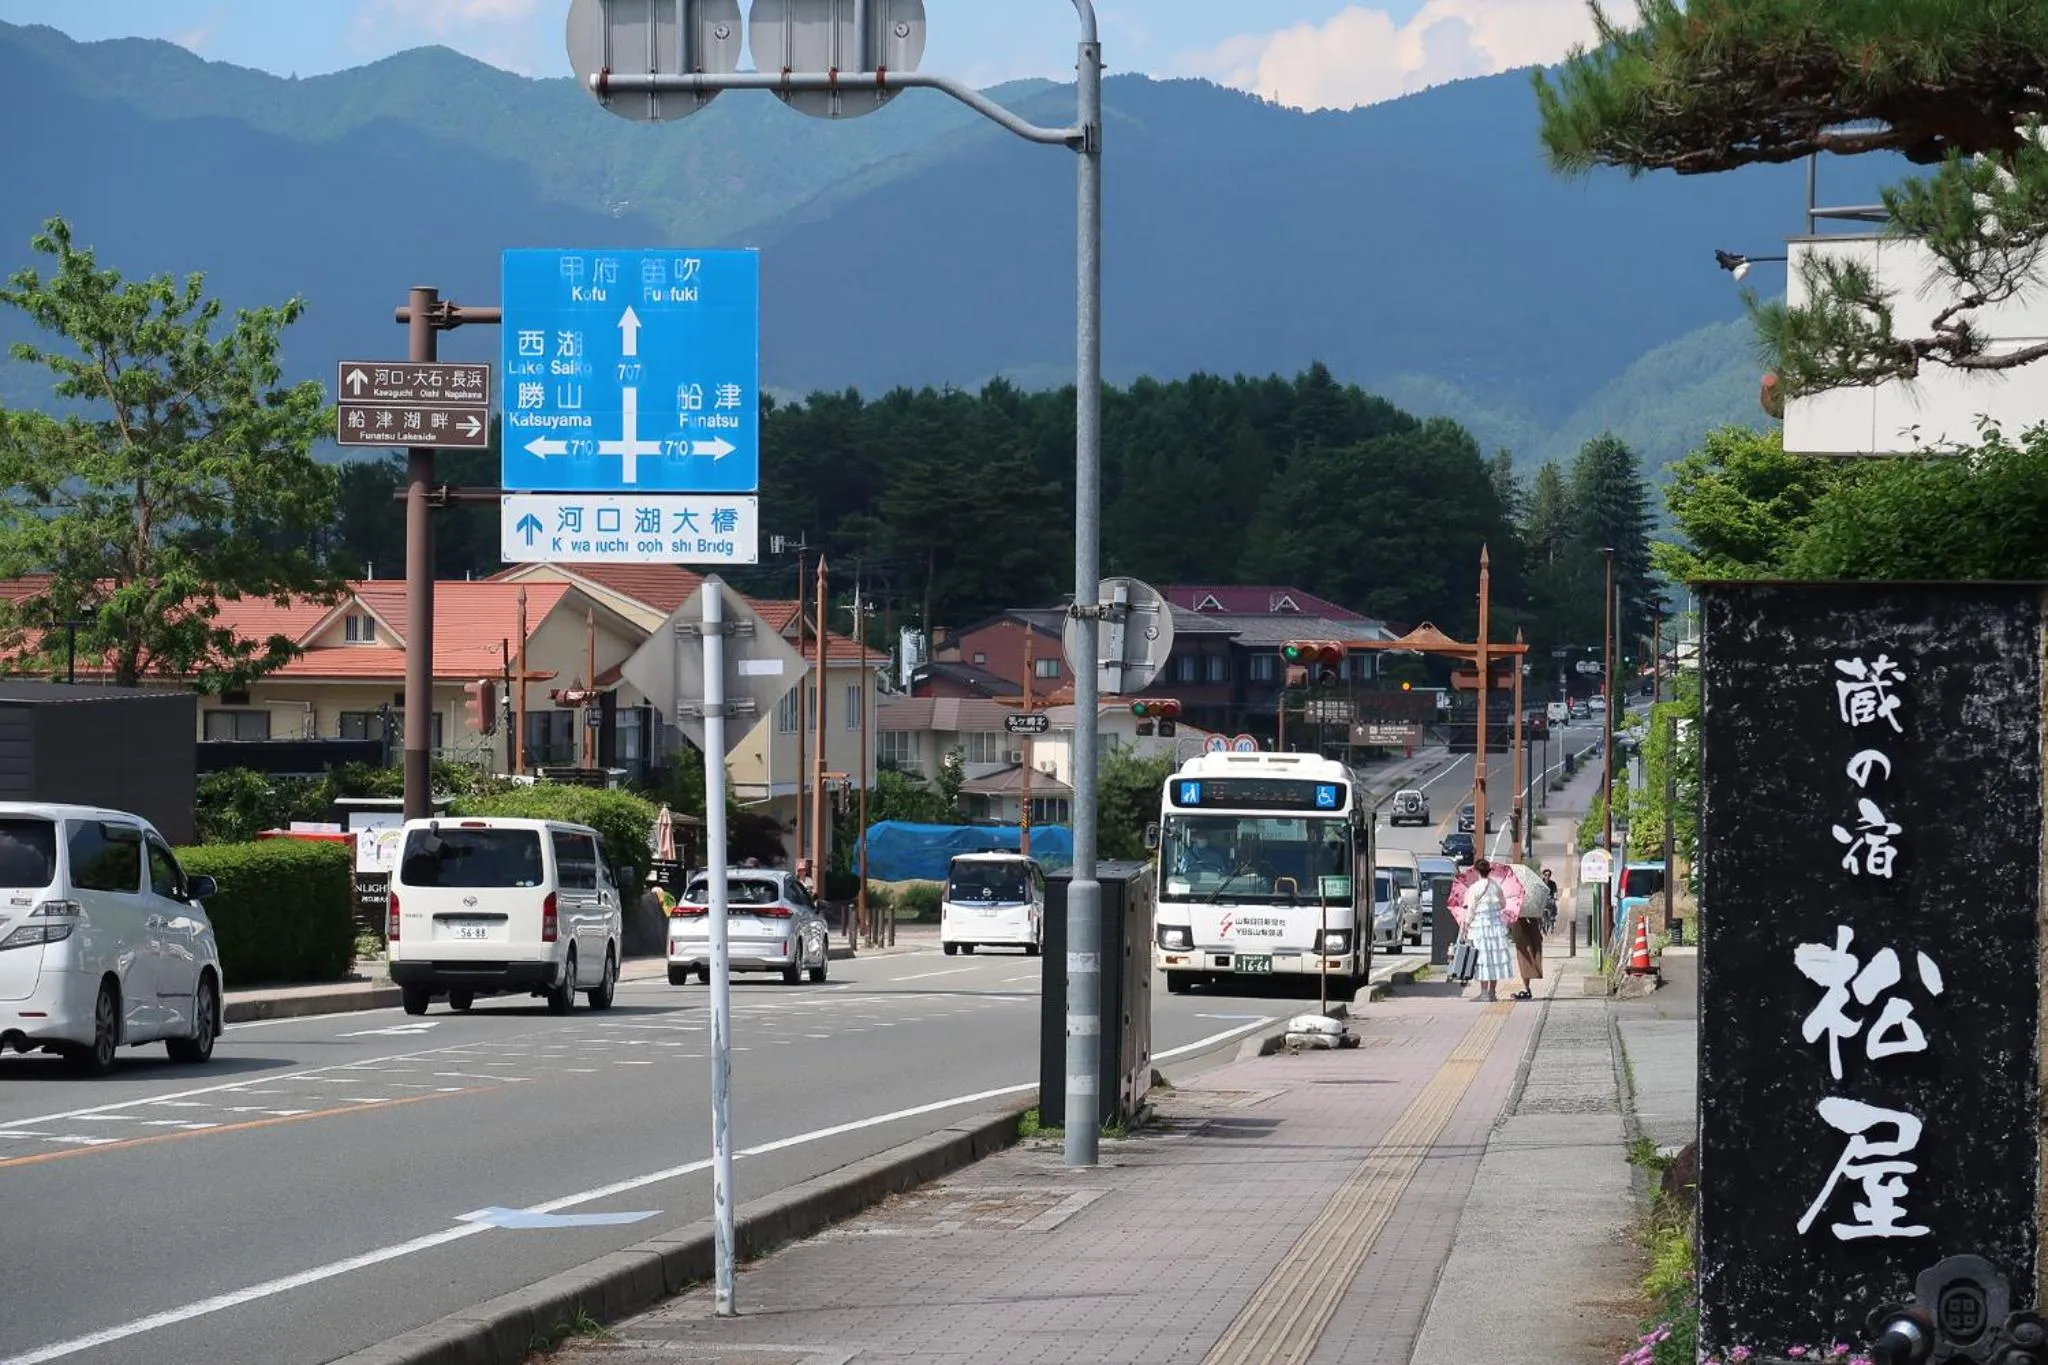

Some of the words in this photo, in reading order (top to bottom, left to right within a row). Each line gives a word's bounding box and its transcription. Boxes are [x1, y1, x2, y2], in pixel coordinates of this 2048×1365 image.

[559, 255, 619, 284] 甲府
[640, 255, 701, 284] 笛吹
[572, 286, 607, 301] Kofu
[517, 330, 583, 357] 西湖
[508, 360, 544, 375] Lake
[617, 364, 641, 381] 707
[373, 388, 413, 399] Kawaguchi
[517, 382, 582, 409] 勝山
[676, 382, 742, 411] 船津
[347, 409, 449, 430] 船津湖畔
[509, 412, 592, 430] Katsuyama
[679, 414, 739, 429] Funatsu
[360, 431, 396, 441] Funatsu
[397, 432, 437, 442] Lakeside
[557, 507, 739, 534] 河口湖大橋
[1832, 655, 1906, 879] 蔵の宿
[1794, 925, 1944, 1242] 松屋
